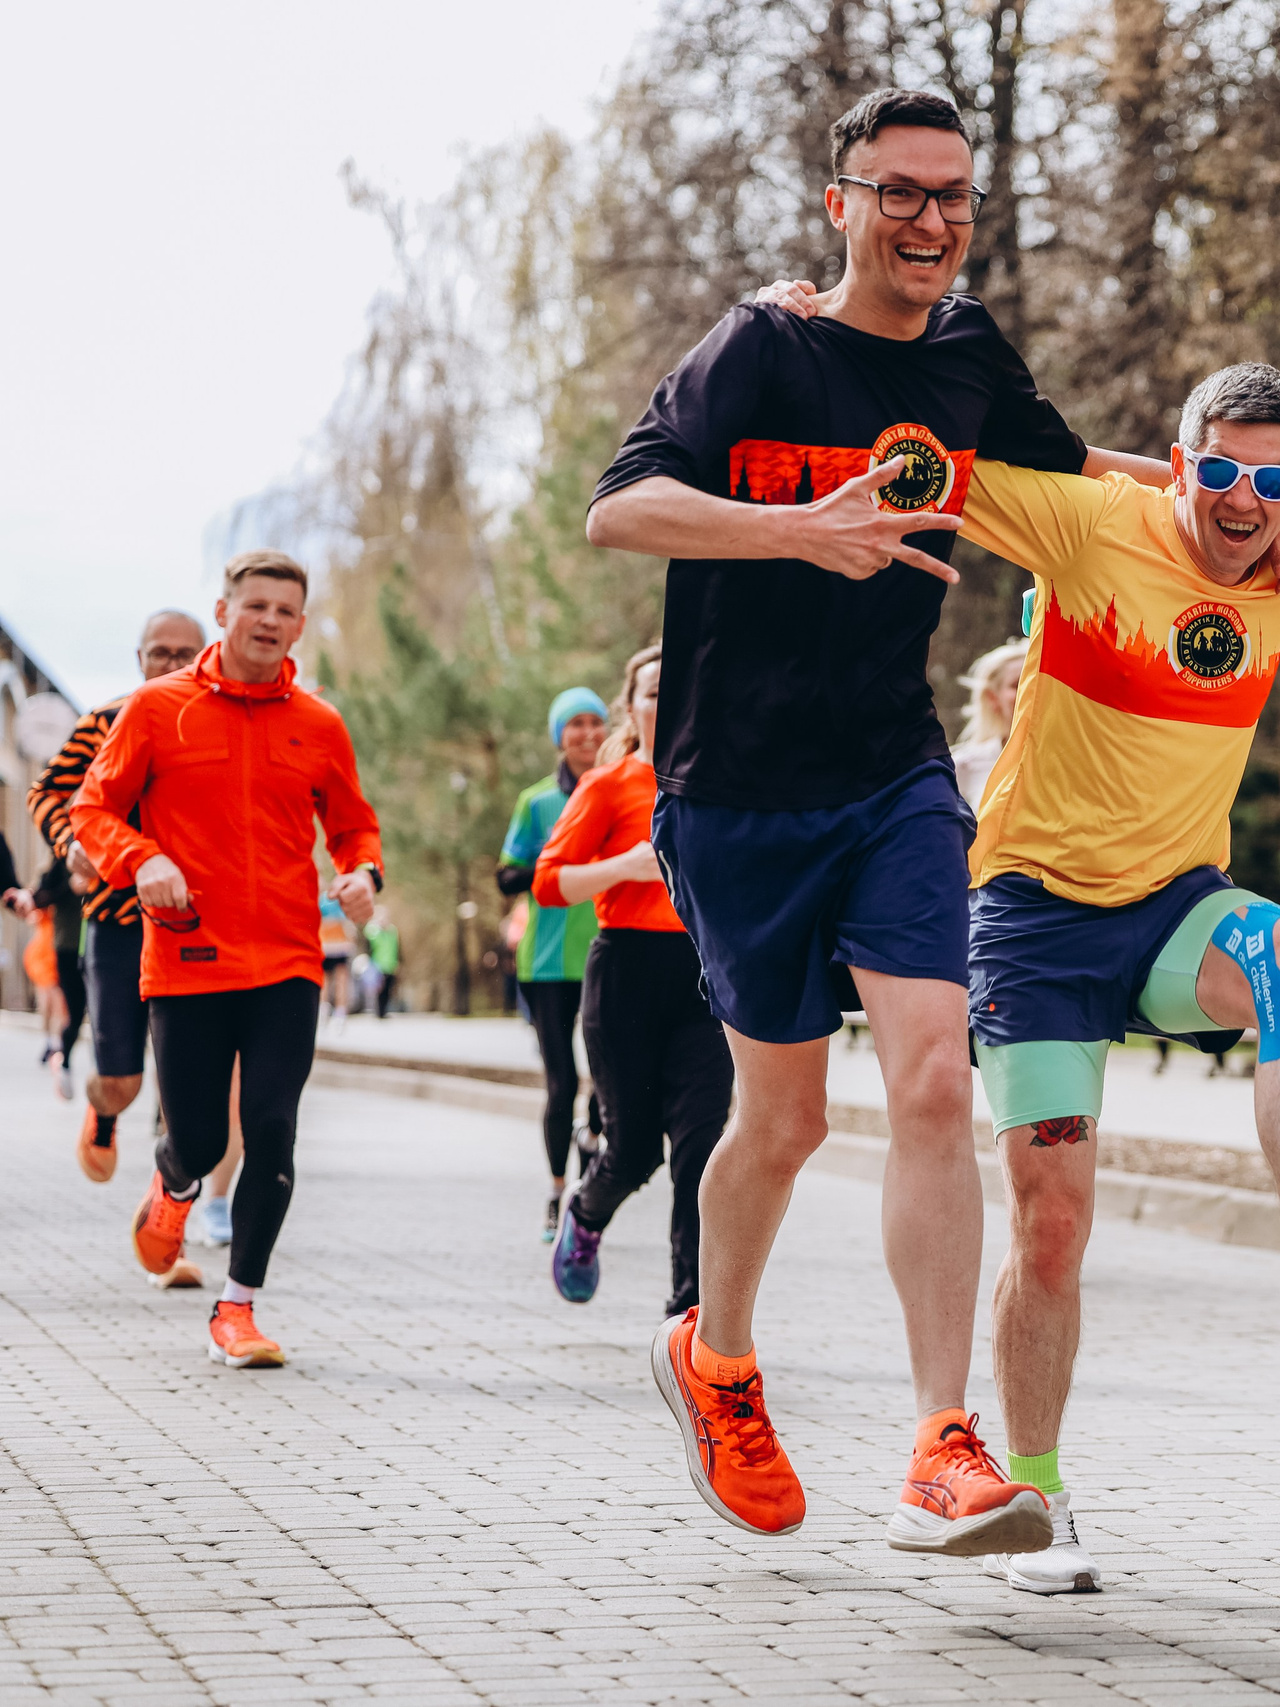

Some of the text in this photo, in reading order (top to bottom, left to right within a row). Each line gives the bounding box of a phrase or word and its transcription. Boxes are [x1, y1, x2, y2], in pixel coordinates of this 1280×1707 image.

[875, 428, 907, 457] SPARTAK
[1177, 604, 1244, 634] SPARTAK MOSCOW
[1184, 650, 1204, 674] SQUAD
[1182, 670, 1233, 689] SUPPORTERS
[1250, 966, 1262, 1004] clinic
[1258, 960, 1276, 1032] millenium
